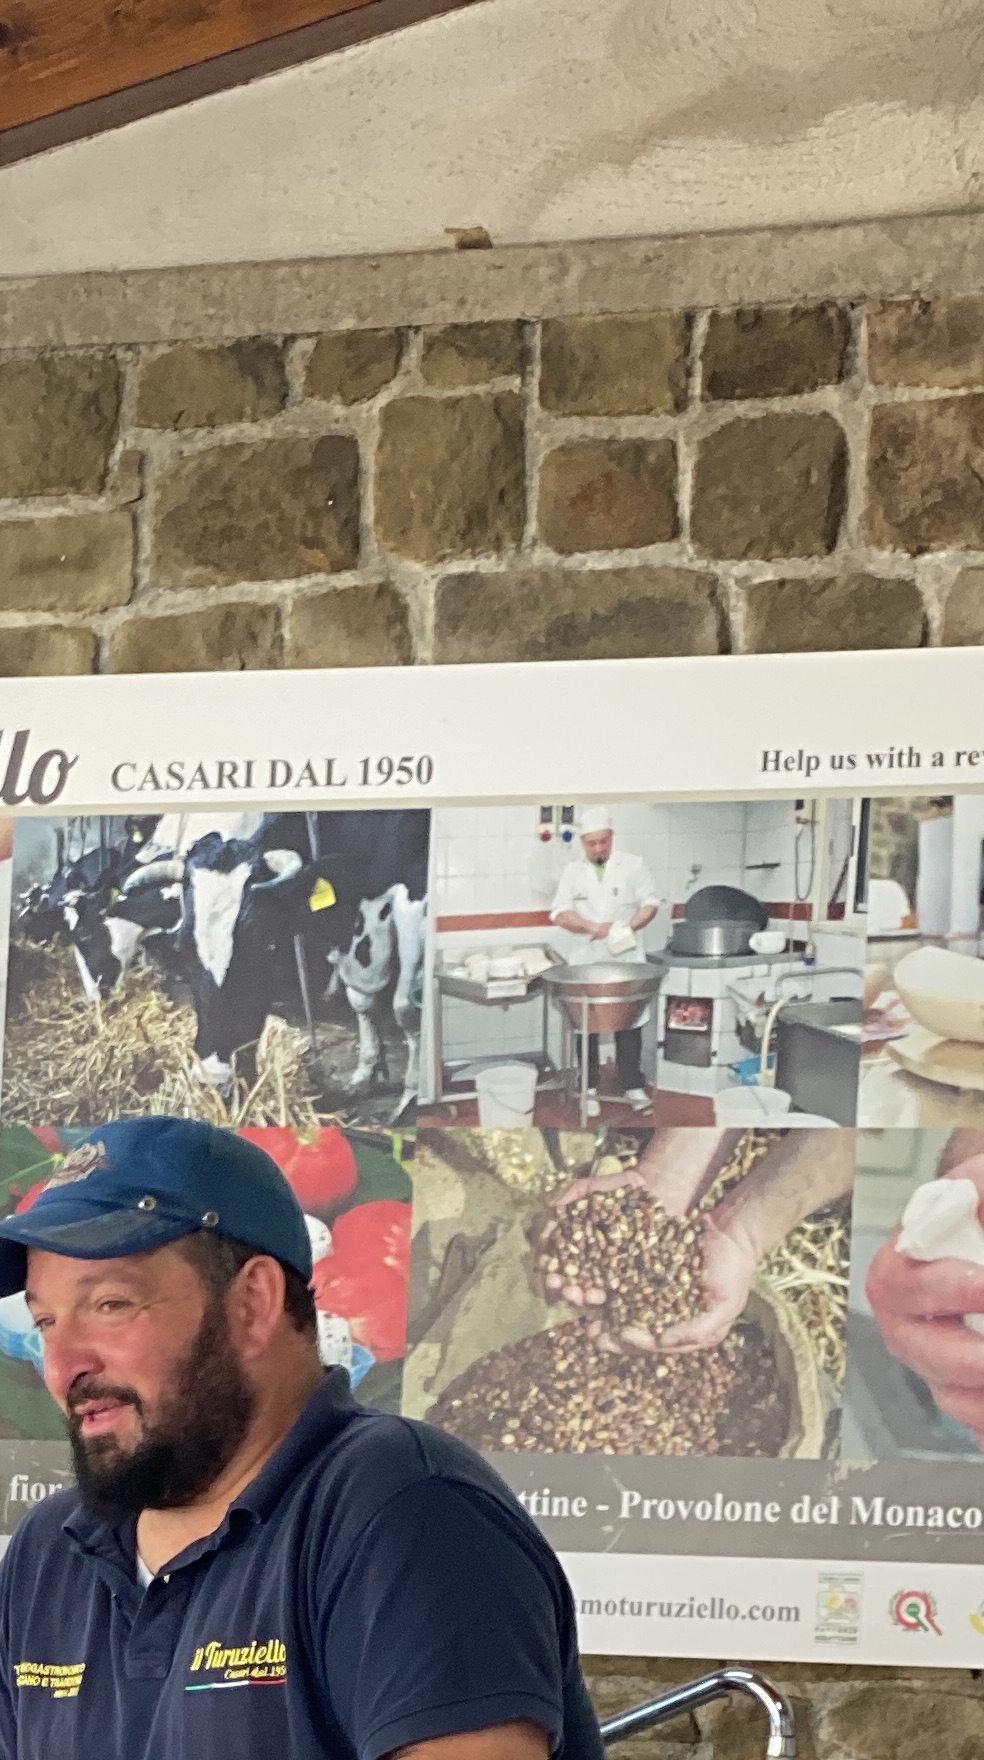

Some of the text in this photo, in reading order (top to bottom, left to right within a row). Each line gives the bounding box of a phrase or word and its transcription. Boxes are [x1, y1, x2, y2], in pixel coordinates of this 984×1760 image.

[110, 755, 434, 793] CASARI DAL 1950
[761, 749, 820, 777] Help
[829, 753, 857, 770] us
[866, 746, 921, 769] with
[931, 750, 945, 767] a
[618, 1490, 781, 1523] Provolone
[790, 1495, 839, 1525] del
[849, 1497, 983, 1529] Monaco
[575, 1597, 801, 1622] moturuziello.com
